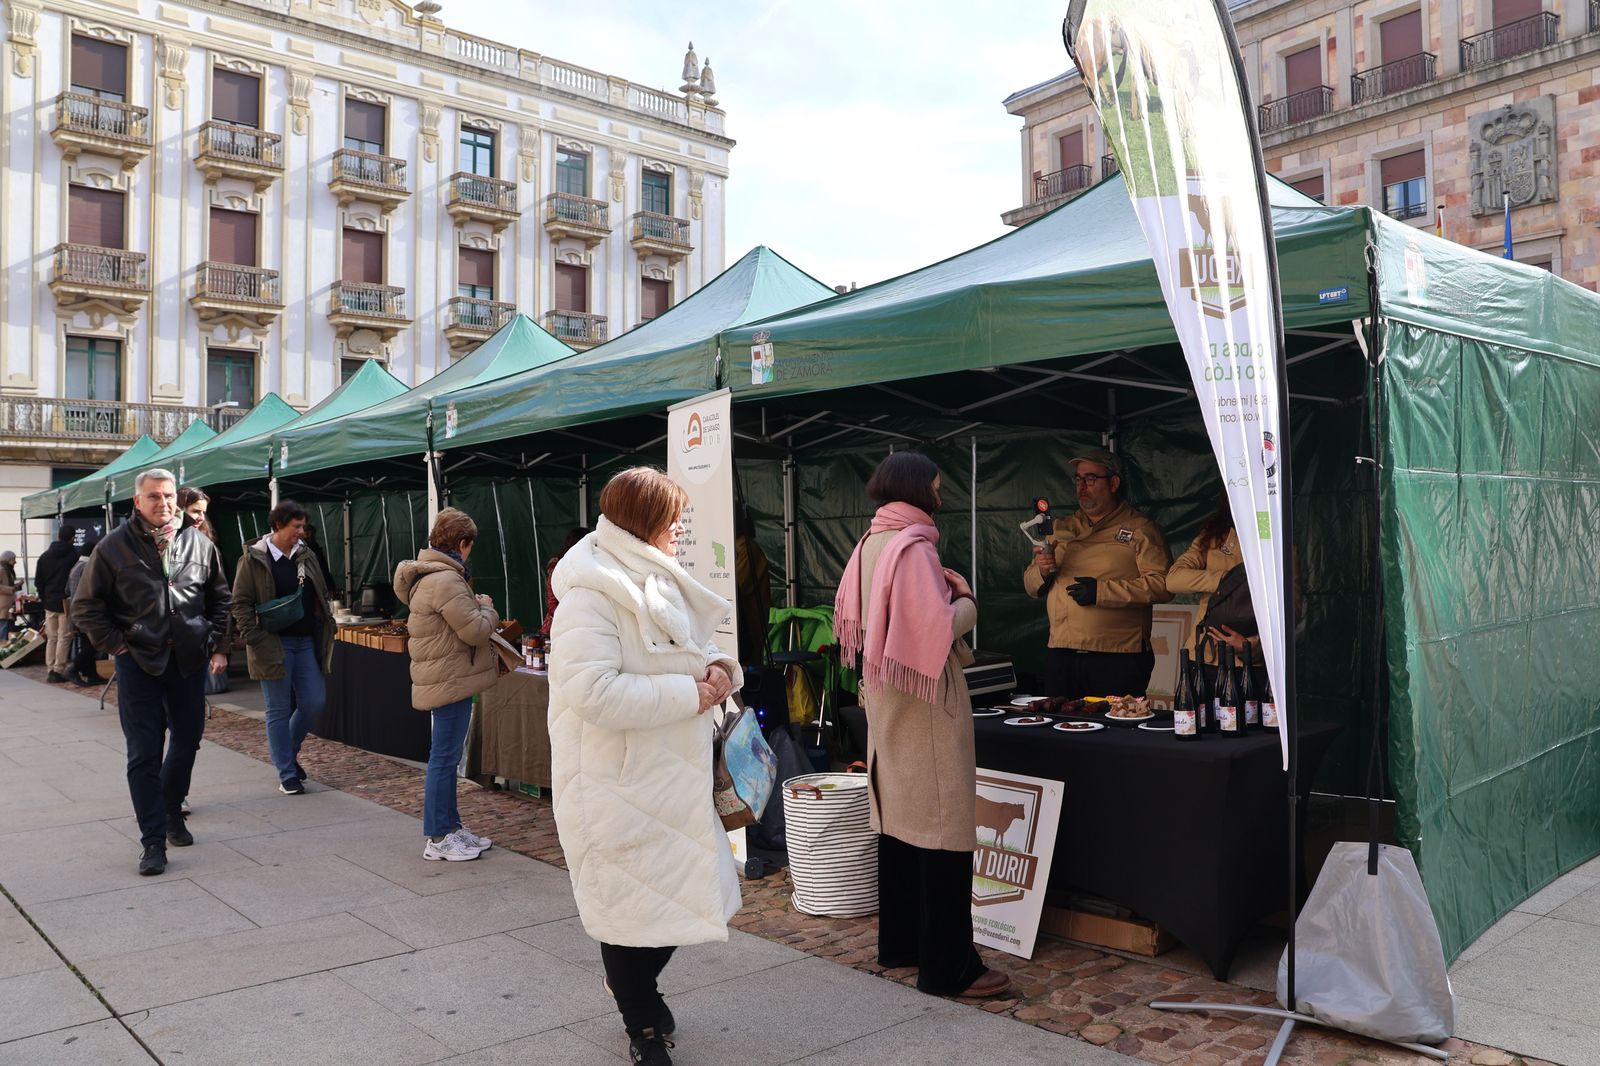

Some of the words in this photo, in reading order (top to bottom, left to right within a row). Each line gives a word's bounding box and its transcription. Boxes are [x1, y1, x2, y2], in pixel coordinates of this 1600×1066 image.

[776, 368, 788, 381] DE
[790, 361, 833, 379] ZAMORA
[985, 851, 1030, 885] DURII
[988, 919, 1016, 934] ECOLÓGICO
